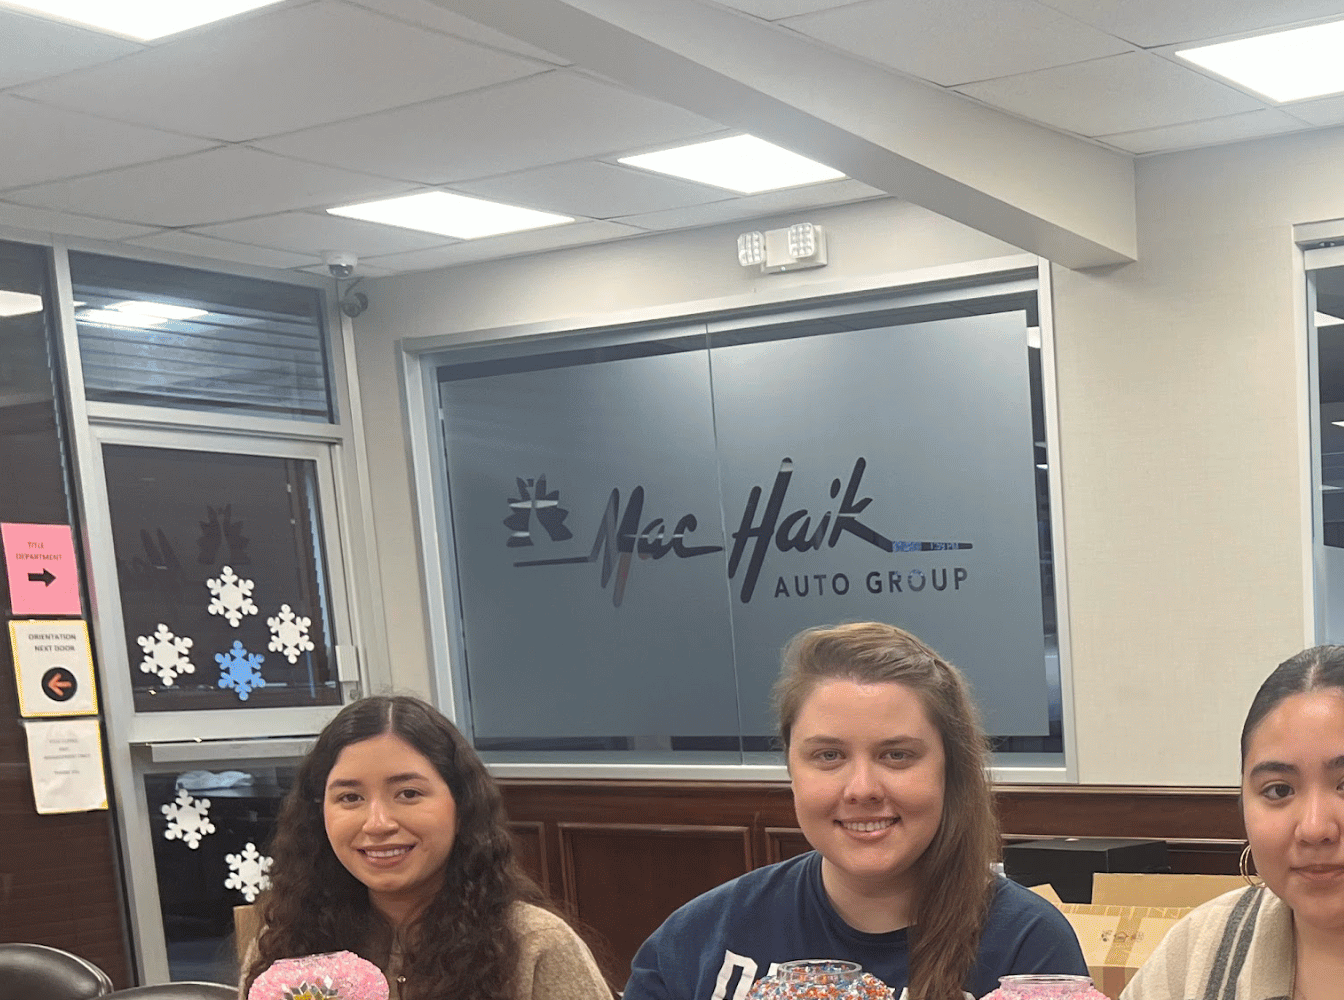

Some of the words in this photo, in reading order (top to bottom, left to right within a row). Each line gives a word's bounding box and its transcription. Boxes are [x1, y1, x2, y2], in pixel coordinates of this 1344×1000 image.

[513, 485, 724, 608] Mac
[728, 456, 974, 604] Haik
[15, 553, 62, 561] DEPARTMENT
[774, 572, 850, 598] AUTO
[866, 567, 968, 594] GROUP
[34, 644, 53, 652] NEXT
[53, 644, 75, 652] DOOR
